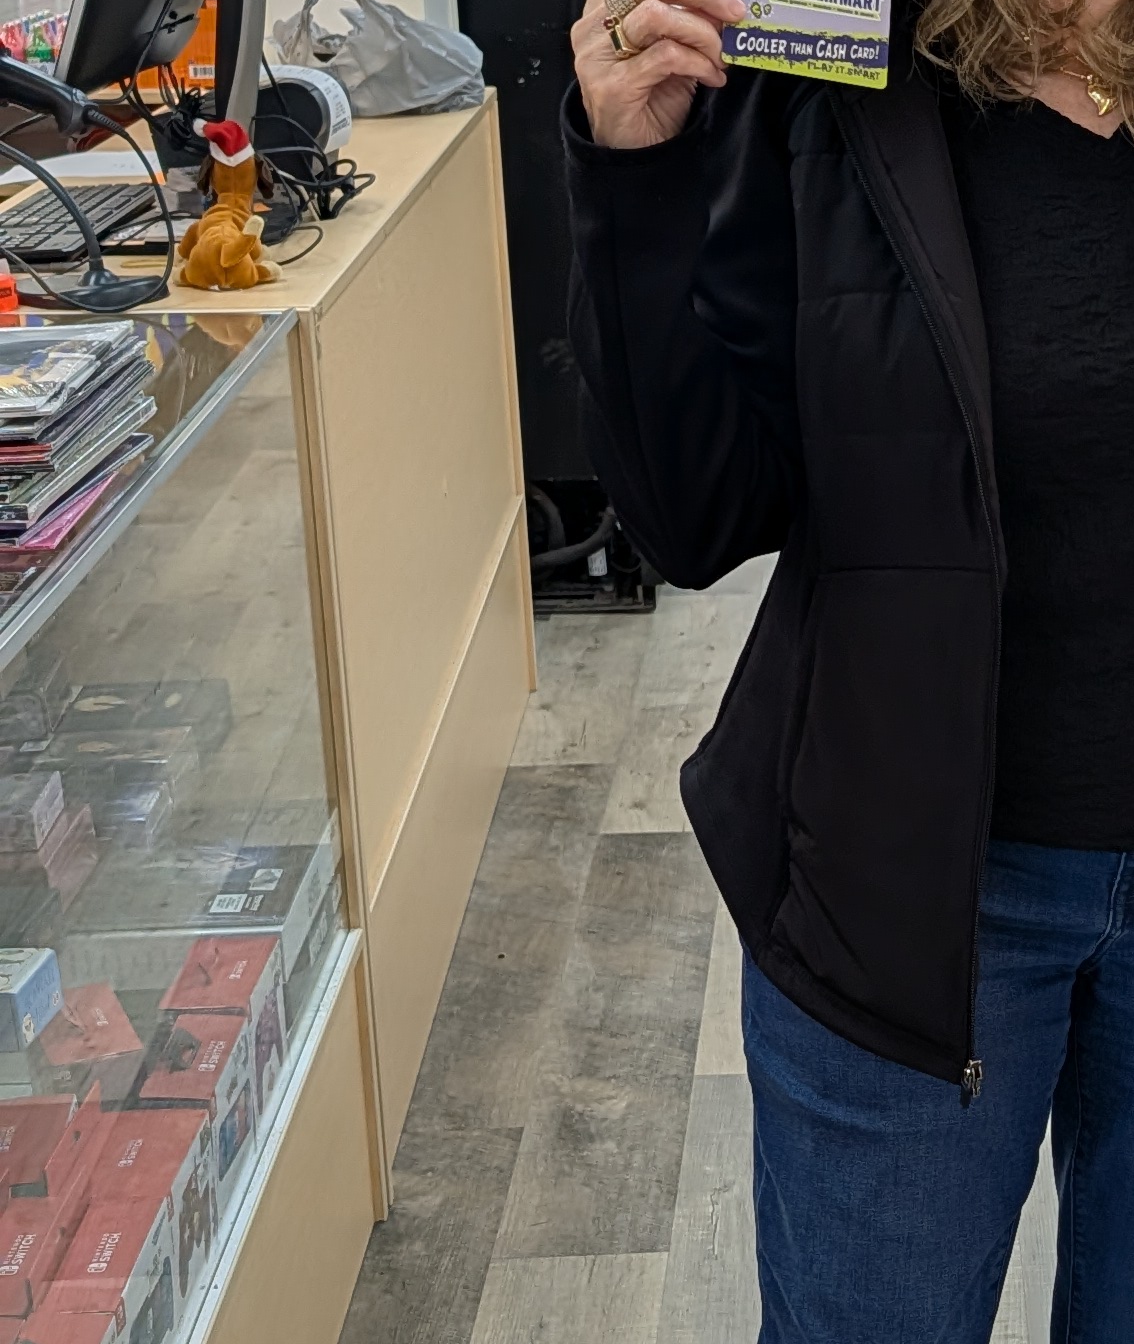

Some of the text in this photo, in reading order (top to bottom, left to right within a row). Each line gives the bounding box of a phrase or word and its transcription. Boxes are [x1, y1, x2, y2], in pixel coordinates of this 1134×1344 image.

[736, 31, 880, 60] COOLER THAN CASH CARD!
[11, 1233, 37, 1266] SWITCH
[99, 1231, 122, 1262] SWITCH
